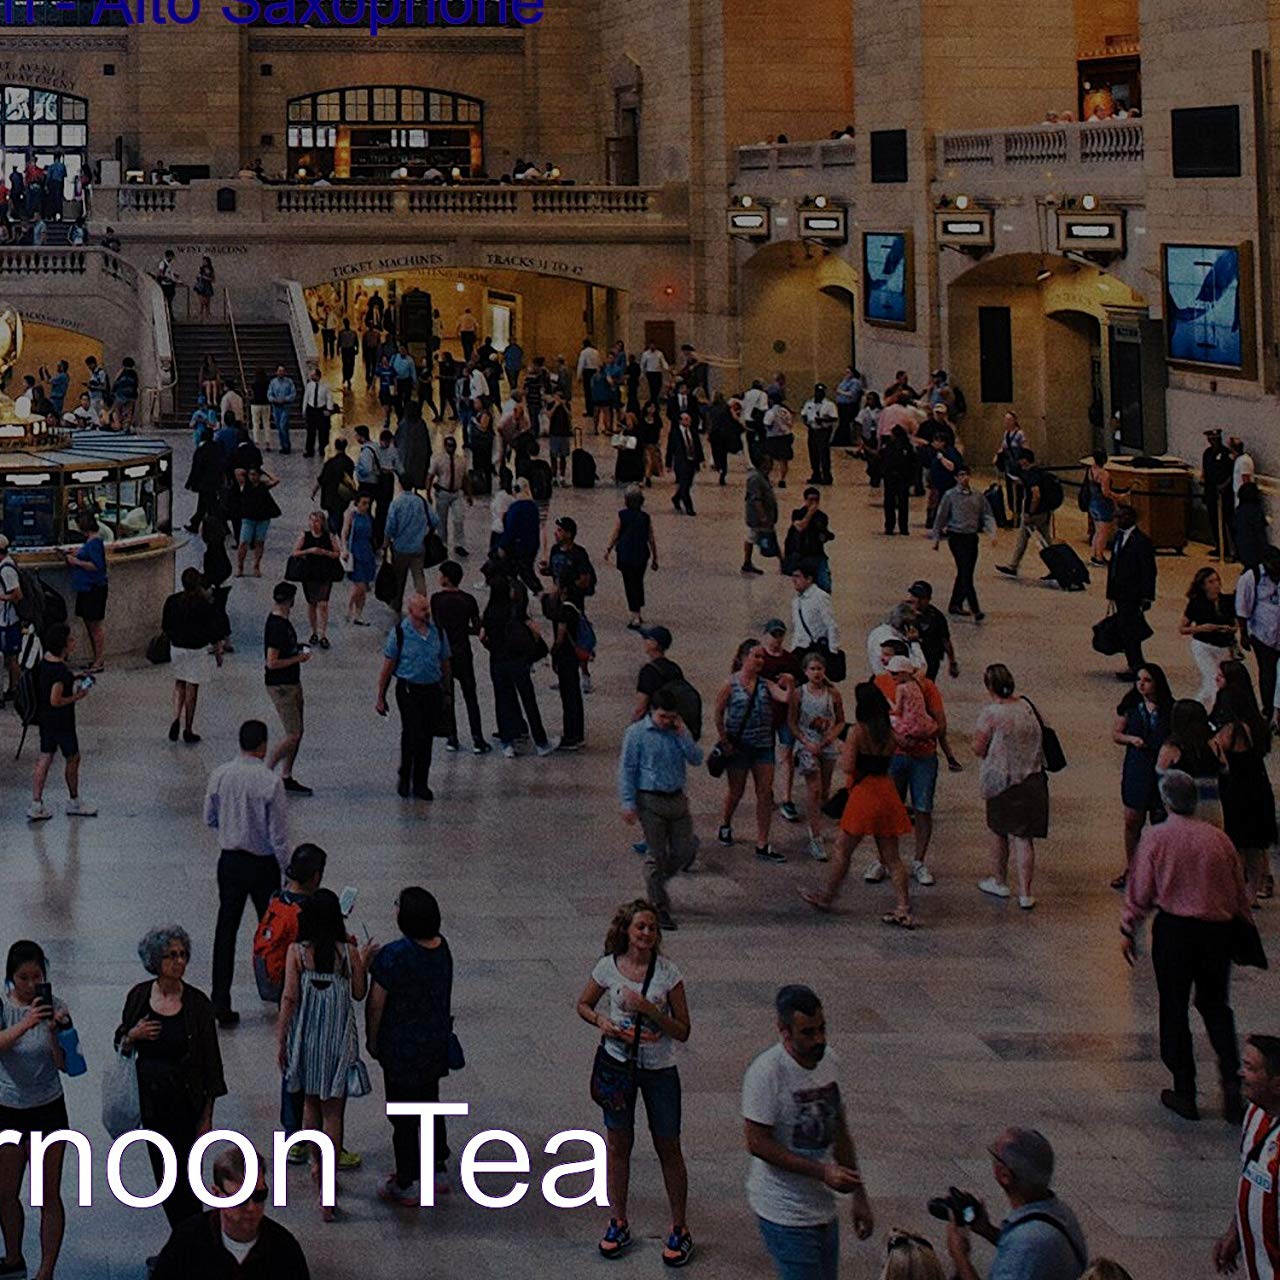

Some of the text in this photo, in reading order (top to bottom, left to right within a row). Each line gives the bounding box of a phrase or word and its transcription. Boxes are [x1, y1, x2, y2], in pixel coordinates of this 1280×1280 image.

[19, 63, 67, 77] AVENUE
[4, 72, 76, 91] APARTMENT
[332, 254, 445, 277] TICKET MACHINES
[487, 254, 535, 267] TRACKS
[551, 261, 569, 272] TO
